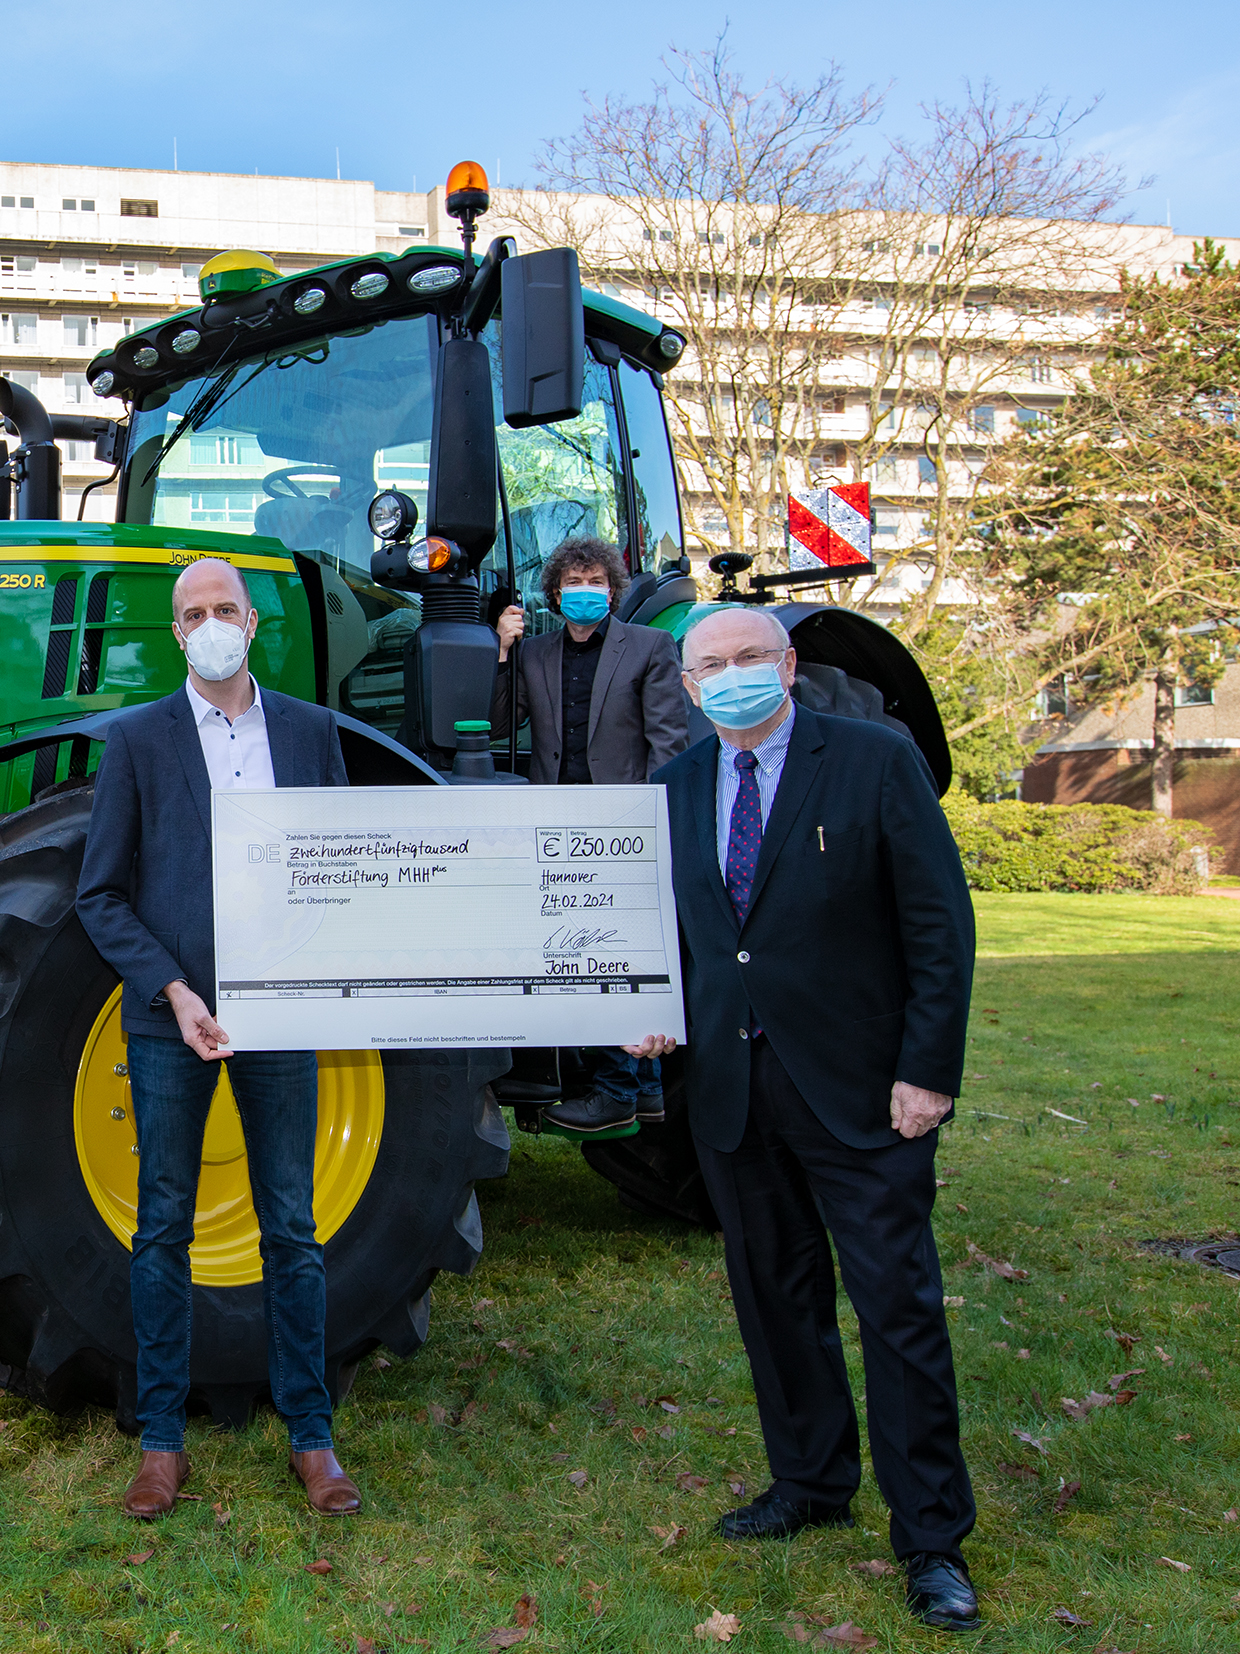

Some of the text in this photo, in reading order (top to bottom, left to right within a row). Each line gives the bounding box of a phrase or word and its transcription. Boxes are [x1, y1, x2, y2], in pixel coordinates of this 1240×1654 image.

[169, 551, 197, 565] JOHN
[33, 573, 46, 589] R
[321, 834, 342, 842] gegen
[366, 832, 392, 840] Scheck
[247, 843, 281, 864] DE
[543, 836, 644, 857] € 250.000
[286, 861, 309, 869] Betrag
[319, 860, 358, 868] Buchstaben
[291, 869, 389, 888] Förderstiftung
[541, 869, 599, 885] Hannover
[306, 896, 352, 906] Überbringer
[541, 893, 614, 909] 24.02.2021
[543, 951, 582, 959] Unterschrift
[544, 957, 630, 975] John Deere
[489, 1035, 527, 1043] bestempeln
